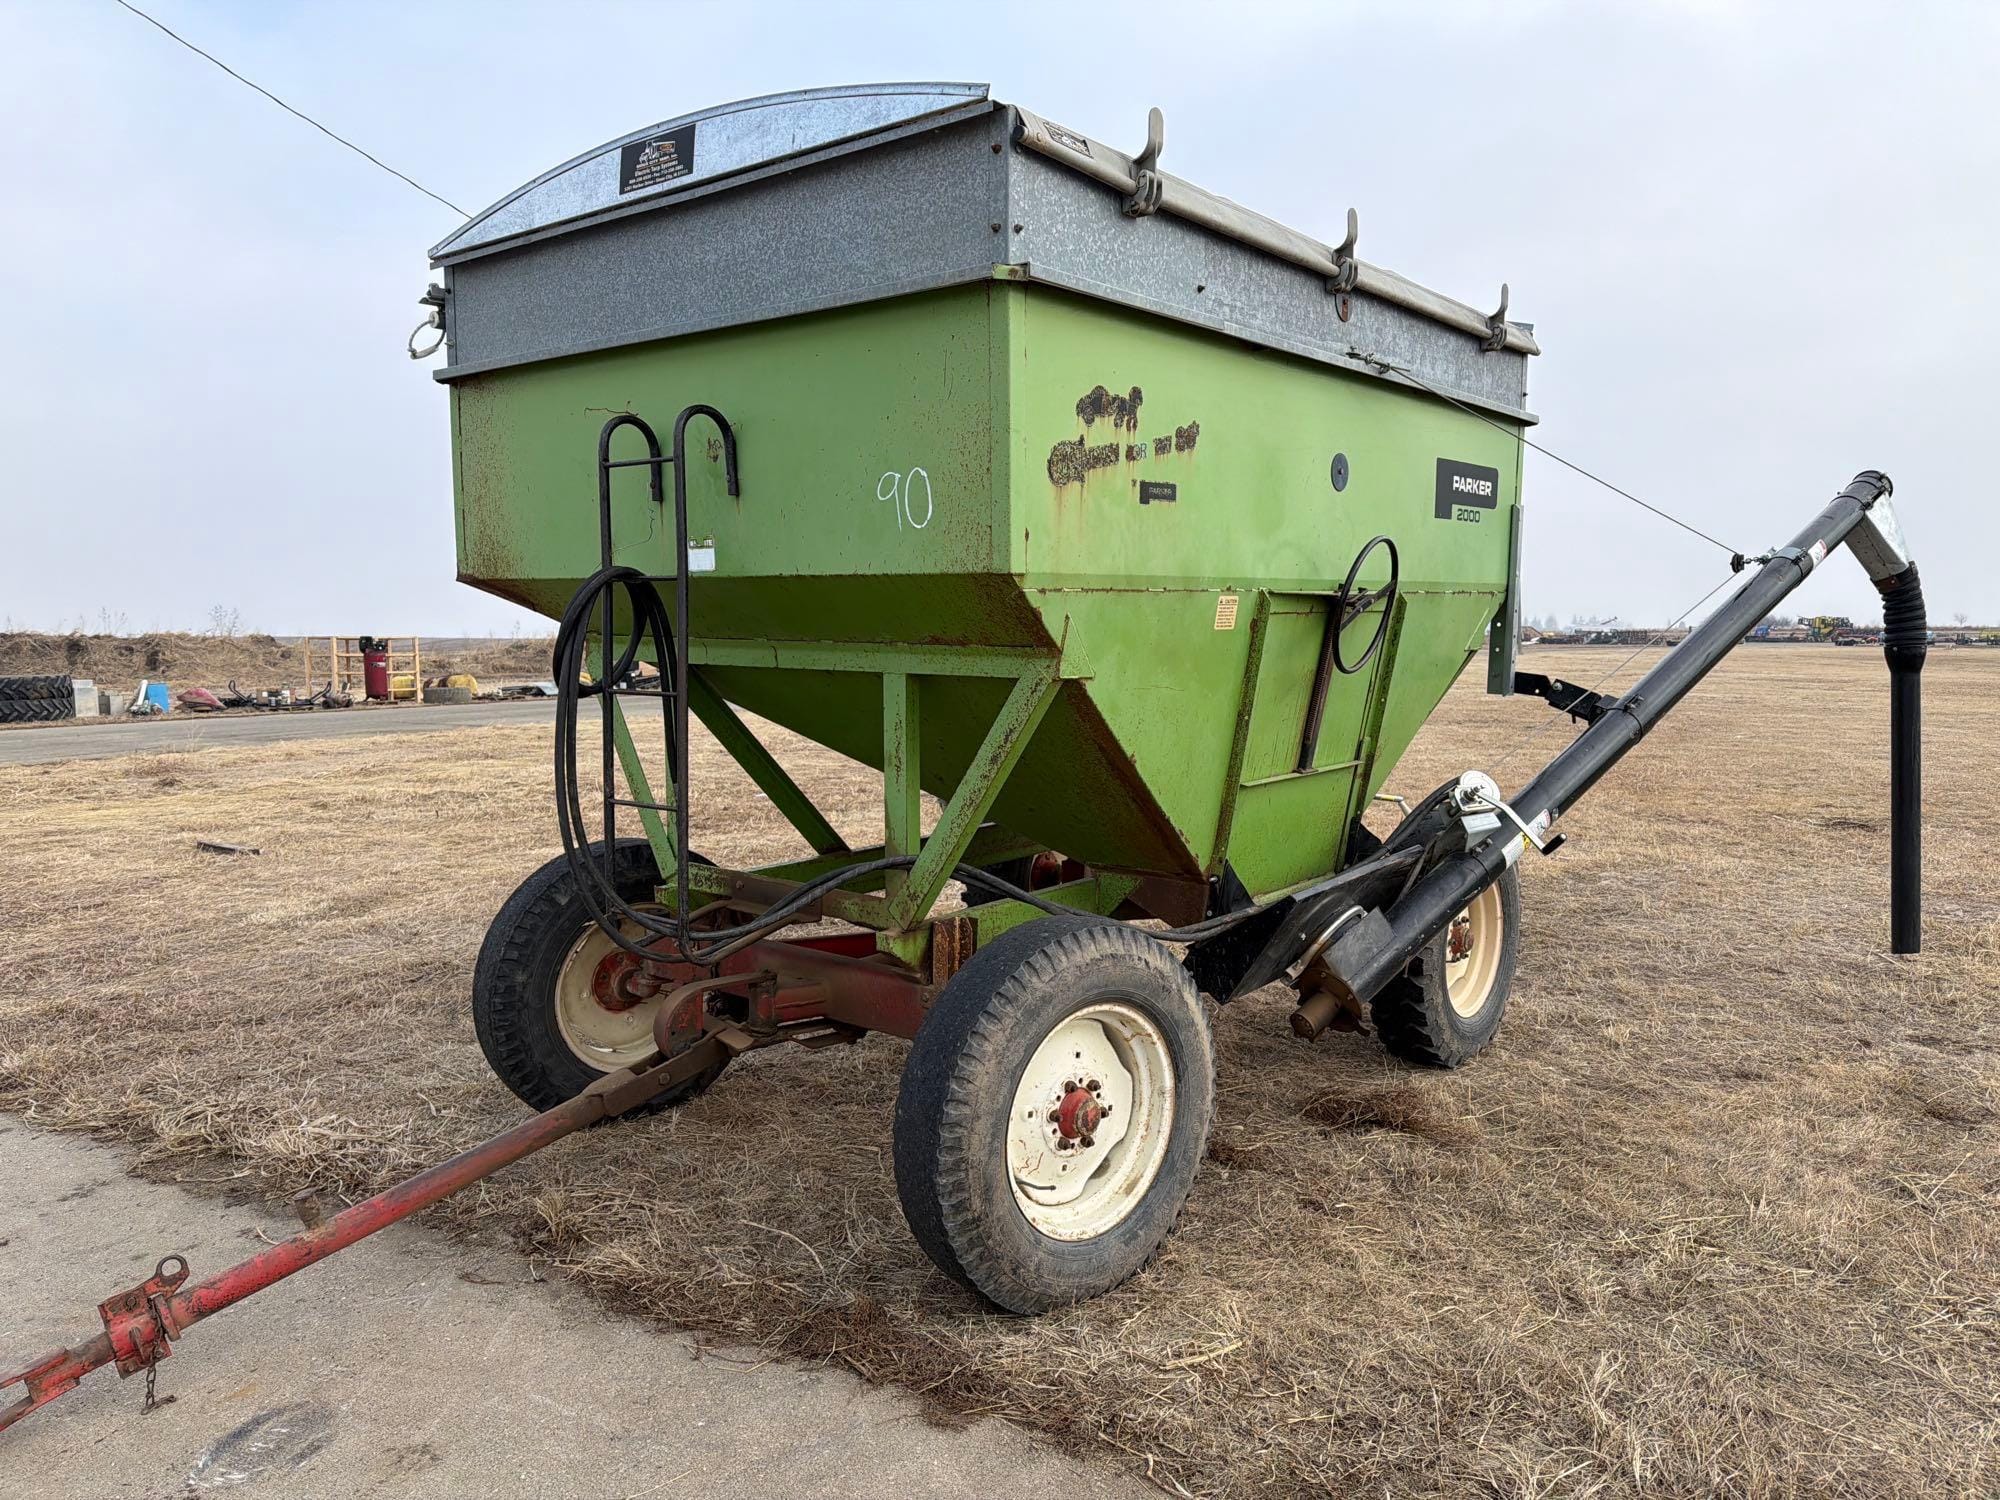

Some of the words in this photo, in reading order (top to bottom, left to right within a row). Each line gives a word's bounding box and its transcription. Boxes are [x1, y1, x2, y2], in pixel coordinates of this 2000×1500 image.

[1453, 475, 1492, 497] PARKER
[877, 467, 932, 532] 90
[1457, 508, 1481, 523] 2000
